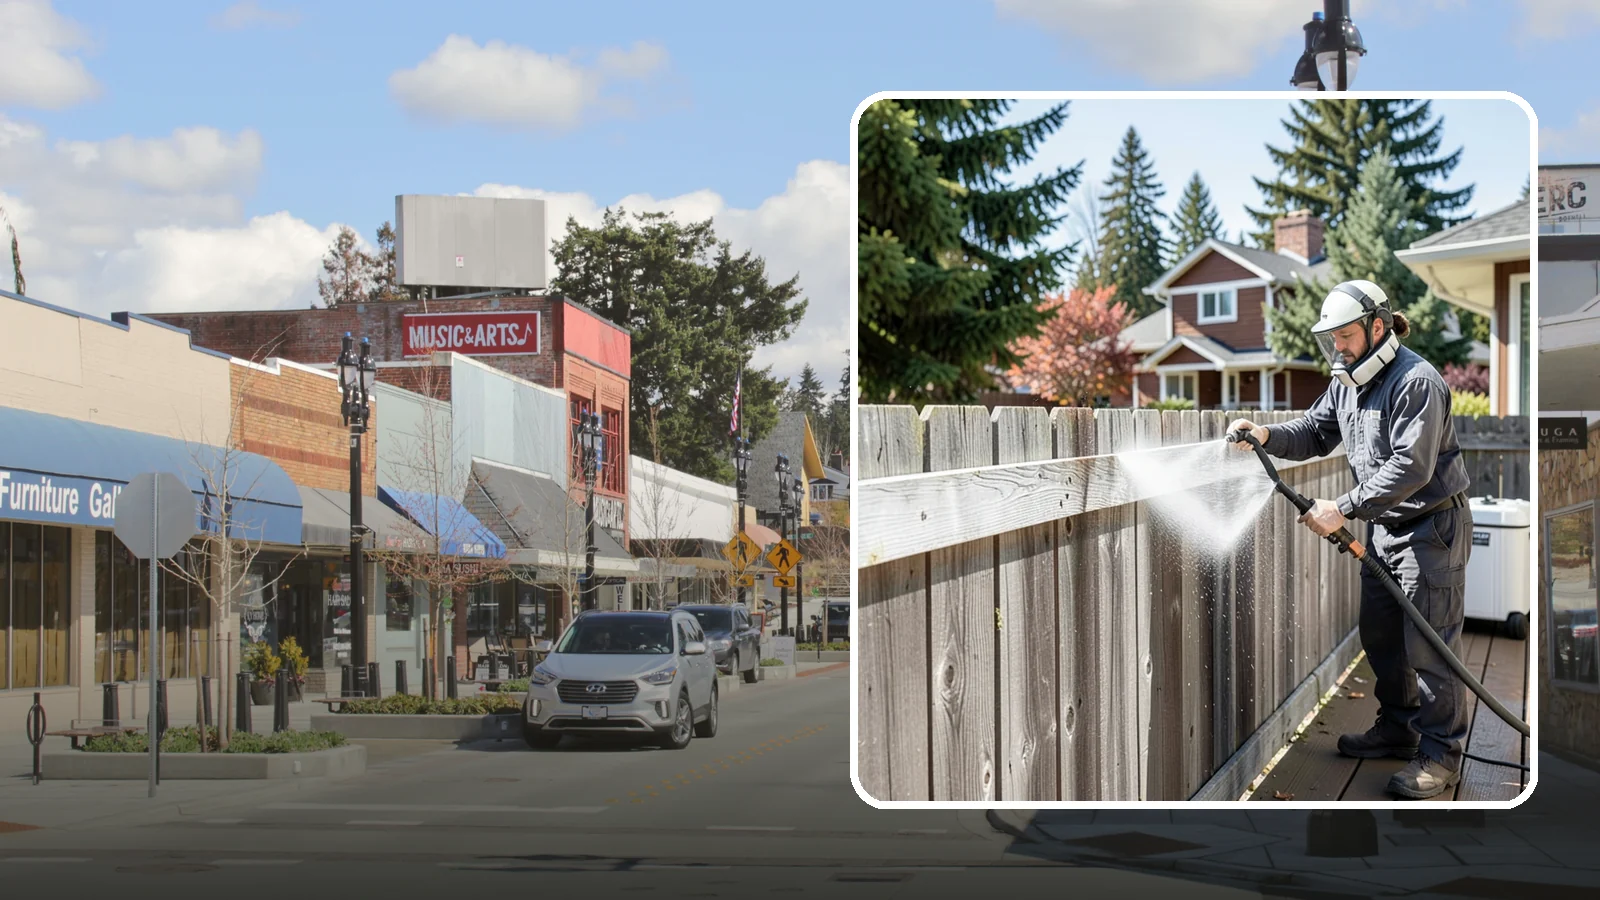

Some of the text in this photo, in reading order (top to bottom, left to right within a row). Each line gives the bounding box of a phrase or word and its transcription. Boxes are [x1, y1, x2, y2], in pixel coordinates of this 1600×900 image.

[409, 323, 519, 349] MUSIC&ARTS
[0, 471, 121, 519] Furniture Gal
[454, 563, 480, 574] SUSHI
